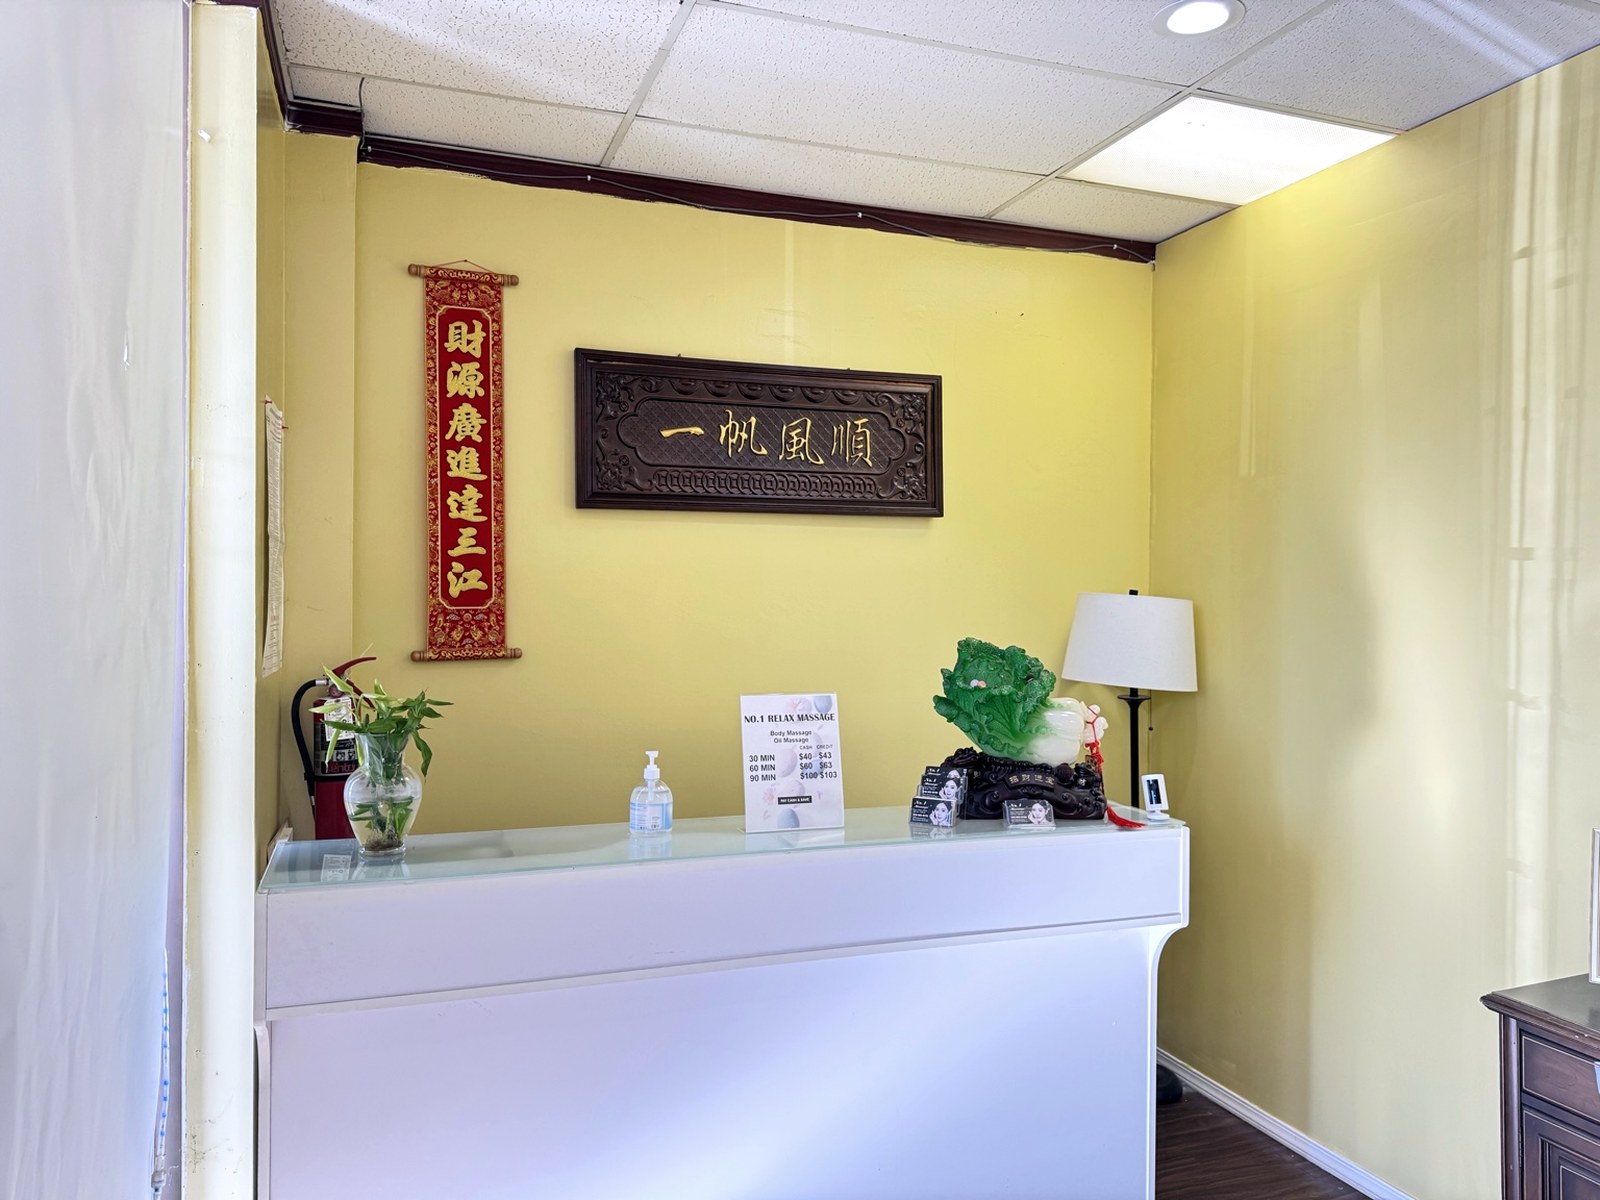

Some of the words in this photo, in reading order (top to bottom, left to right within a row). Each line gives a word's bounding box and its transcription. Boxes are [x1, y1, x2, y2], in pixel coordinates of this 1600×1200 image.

[659, 409, 873, 468] 一帆風順
[444, 319, 488, 598] 財源廣進達三江
[744, 715, 764, 723] NO.1
[768, 714, 795, 722] RELAX
[797, 713, 835, 722] MASSAGE
[749, 764, 759, 772] 60
[800, 762, 813, 770] $60
[819, 761, 832, 769] $63
[749, 774, 759, 782] 90
[800, 772, 818, 780] $100
[820, 771, 837, 779] $103
